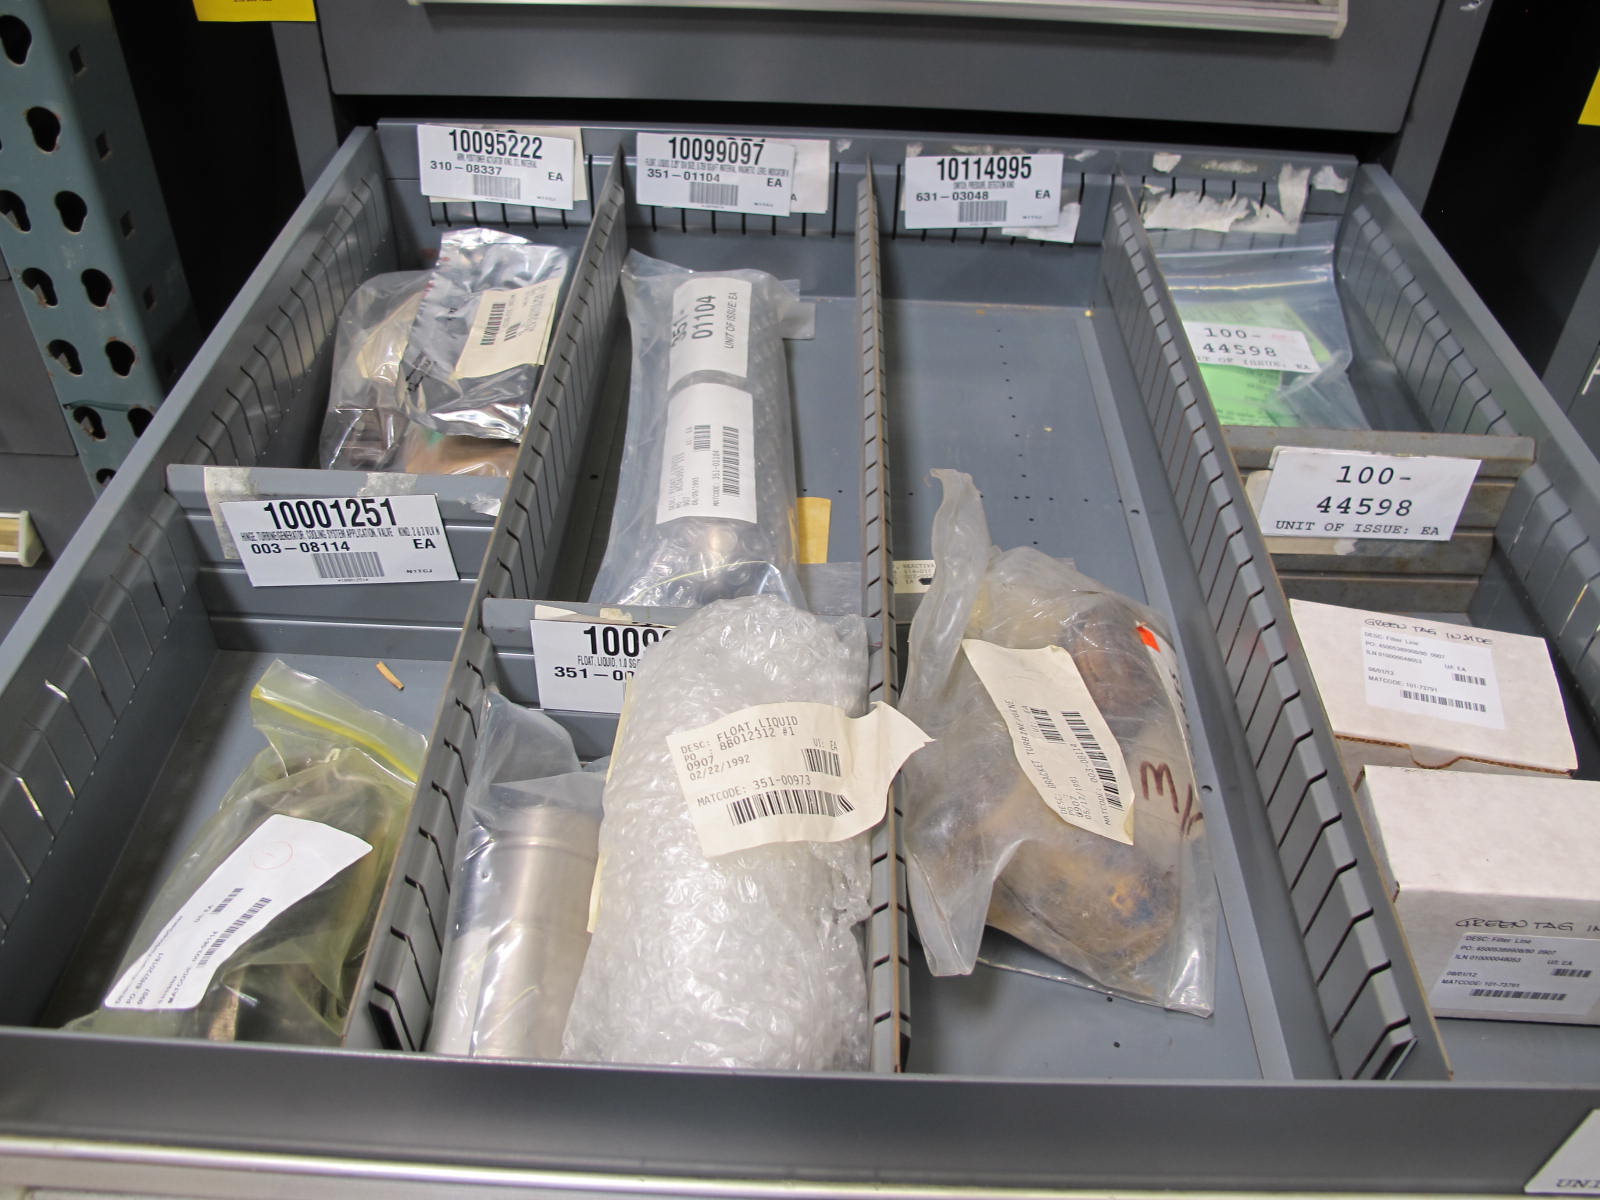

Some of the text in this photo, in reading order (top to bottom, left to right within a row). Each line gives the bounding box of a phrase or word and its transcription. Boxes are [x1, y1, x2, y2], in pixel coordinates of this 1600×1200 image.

[448, 129, 543, 160] 10095222
[668, 136, 765, 165] 10099097
[430, 160, 502, 176] 310-08337
[548, 171, 564, 181] EA
[647, 168, 782, 188] 351-01104 EA
[937, 156, 1032, 181] 10114995
[916, 190, 1051, 202] 631-03048 EA
[691, 295, 717, 340] 01104
[1203, 327, 1262, 339] 100-
[1202, 343, 1278, 357] 44598
[1335, 464, 1412, 486] 100-
[264, 497, 397, 530] 10001251
[1316, 495, 1413, 517] 44598
[1275, 520, 1441, 536] UNIT OF ISSUE: EA
[251, 539, 437, 555] 003-08114 EA
[680, 739, 711, 755] DESC:
[758, 714, 800, 730] LIQUID
[686, 755, 715, 772] 0907
[689, 754, 751, 781] 02/22/1992
[697, 774, 812, 807] MATCODE: 351-00973
[1455, 917, 1528, 930] GREEN
[1534, 921, 1574, 932] TAG
